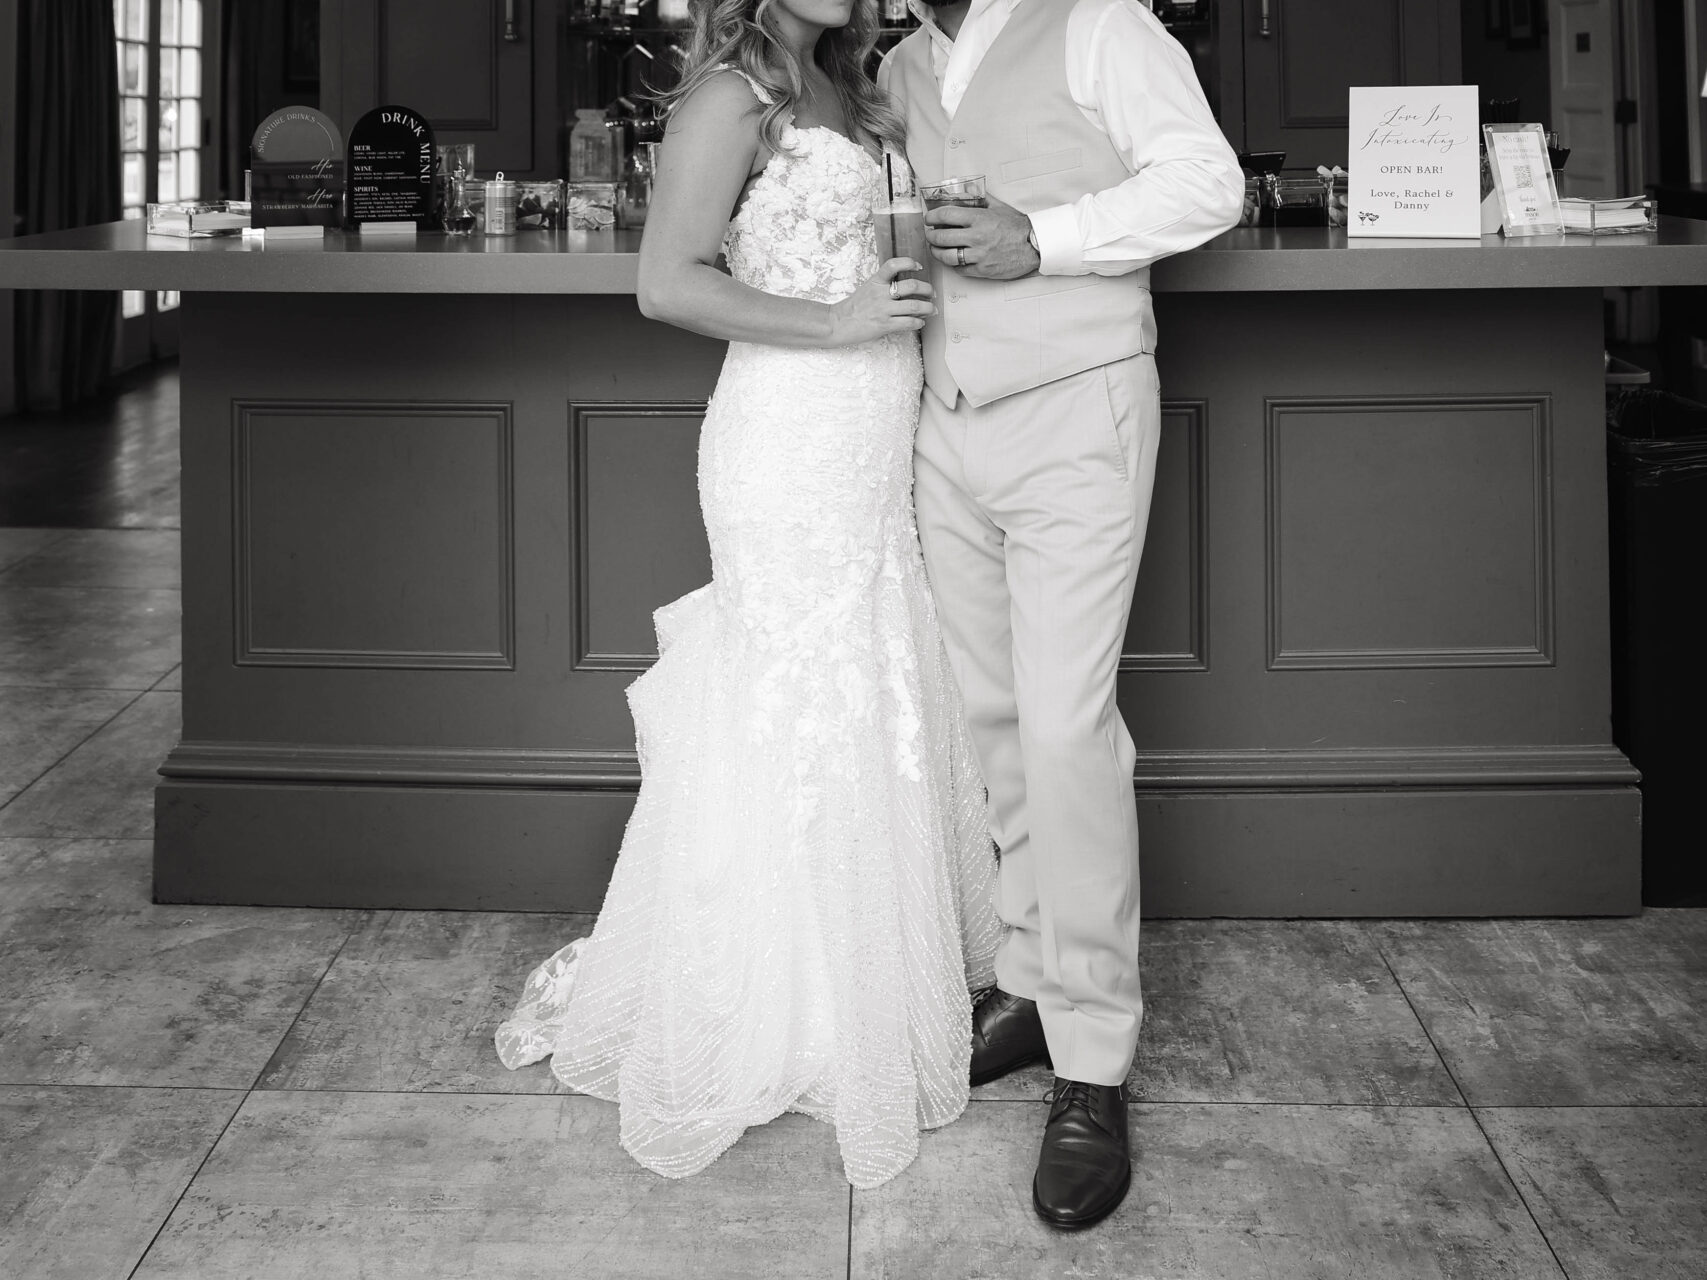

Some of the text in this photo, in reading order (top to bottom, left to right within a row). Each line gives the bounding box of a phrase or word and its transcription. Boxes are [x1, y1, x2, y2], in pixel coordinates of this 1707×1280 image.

[1379, 103, 1453, 127] Love Is
[257, 113, 316, 153] SIGNATURE DRINKS
[1360, 127, 1469, 154] Intoxicating
[381, 112, 431, 184] DRINK MENU
[1380, 165, 1443, 174] OPEN BAR!
[1370, 189, 1454, 199] Love, Rachel &
[1394, 201, 1430, 212] Danny
